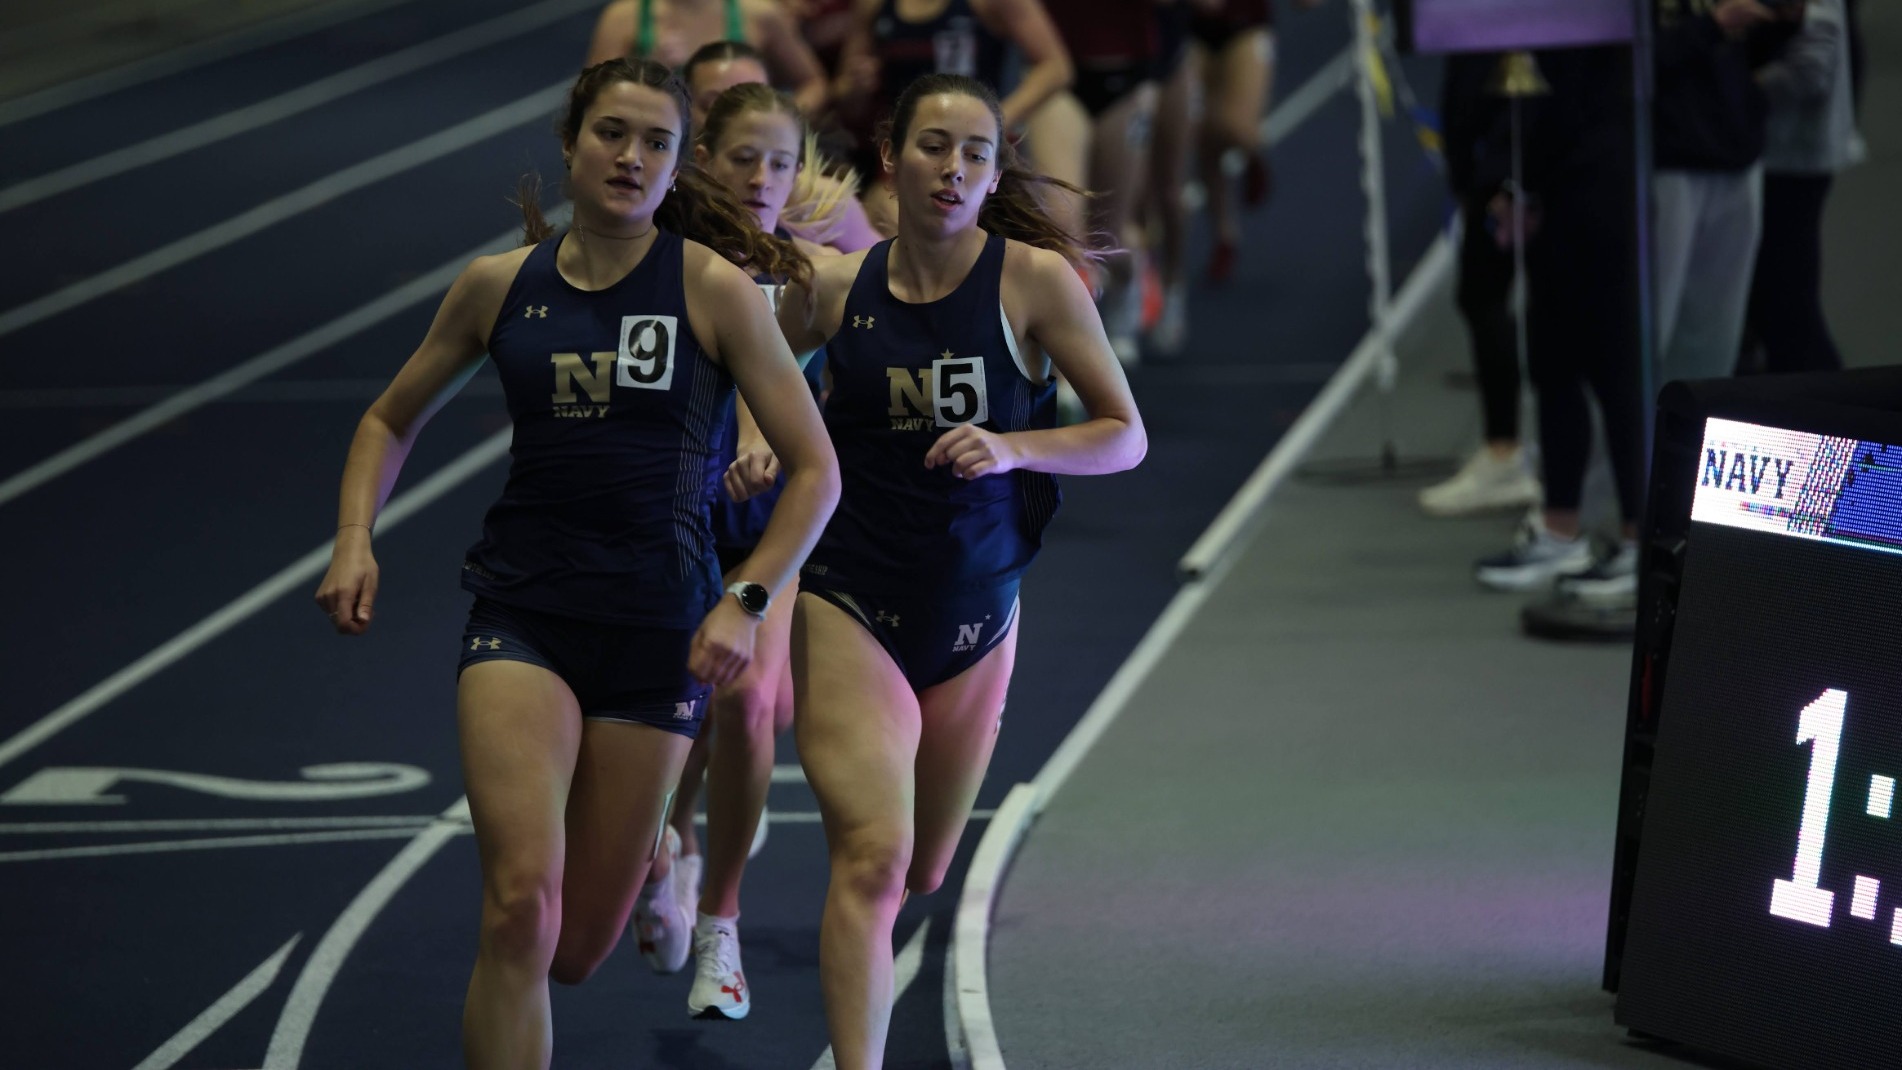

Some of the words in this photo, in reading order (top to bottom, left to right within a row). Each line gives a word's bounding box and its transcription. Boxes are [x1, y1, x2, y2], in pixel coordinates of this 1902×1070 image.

[628, 319, 669, 383] 9
[550, 351, 617, 404] N
[886, 367, 933, 417] N
[939, 362, 978, 423] 5
[552, 404, 611, 419] NAVY
[890, 417, 934, 433] NAVY
[1701, 447, 1794, 499] NAVY
[952, 645, 977, 653] NAVY
[954, 622, 983, 646] N
